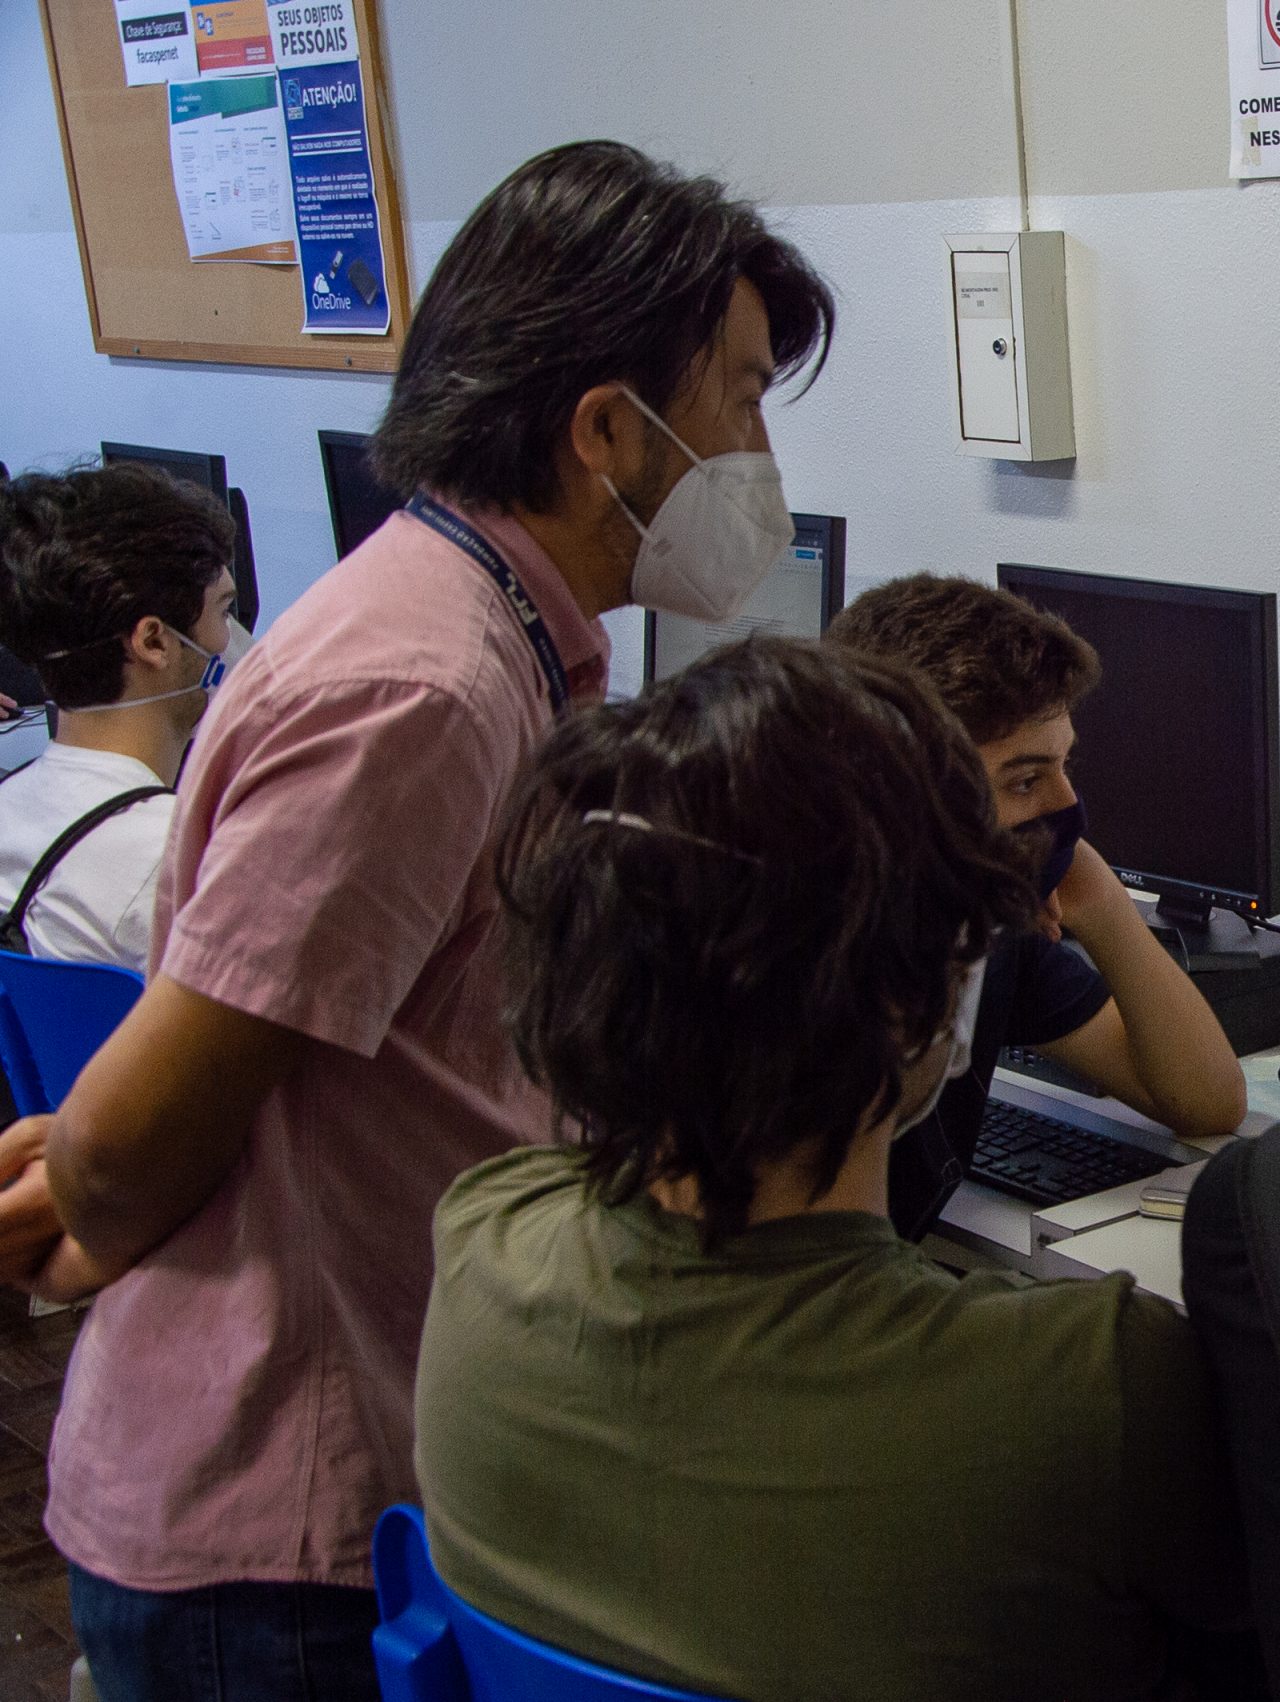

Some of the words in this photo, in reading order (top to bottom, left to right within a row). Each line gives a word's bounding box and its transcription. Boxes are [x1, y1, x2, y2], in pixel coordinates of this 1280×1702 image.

[278, 9, 302, 27] SEUS
[304, 4, 344, 27] OBJETOS
[281, 26, 348, 56] PESSOAIS
[303, 81, 357, 109] ATENÇÃO!
[312, 292, 352, 310] OneDrive
